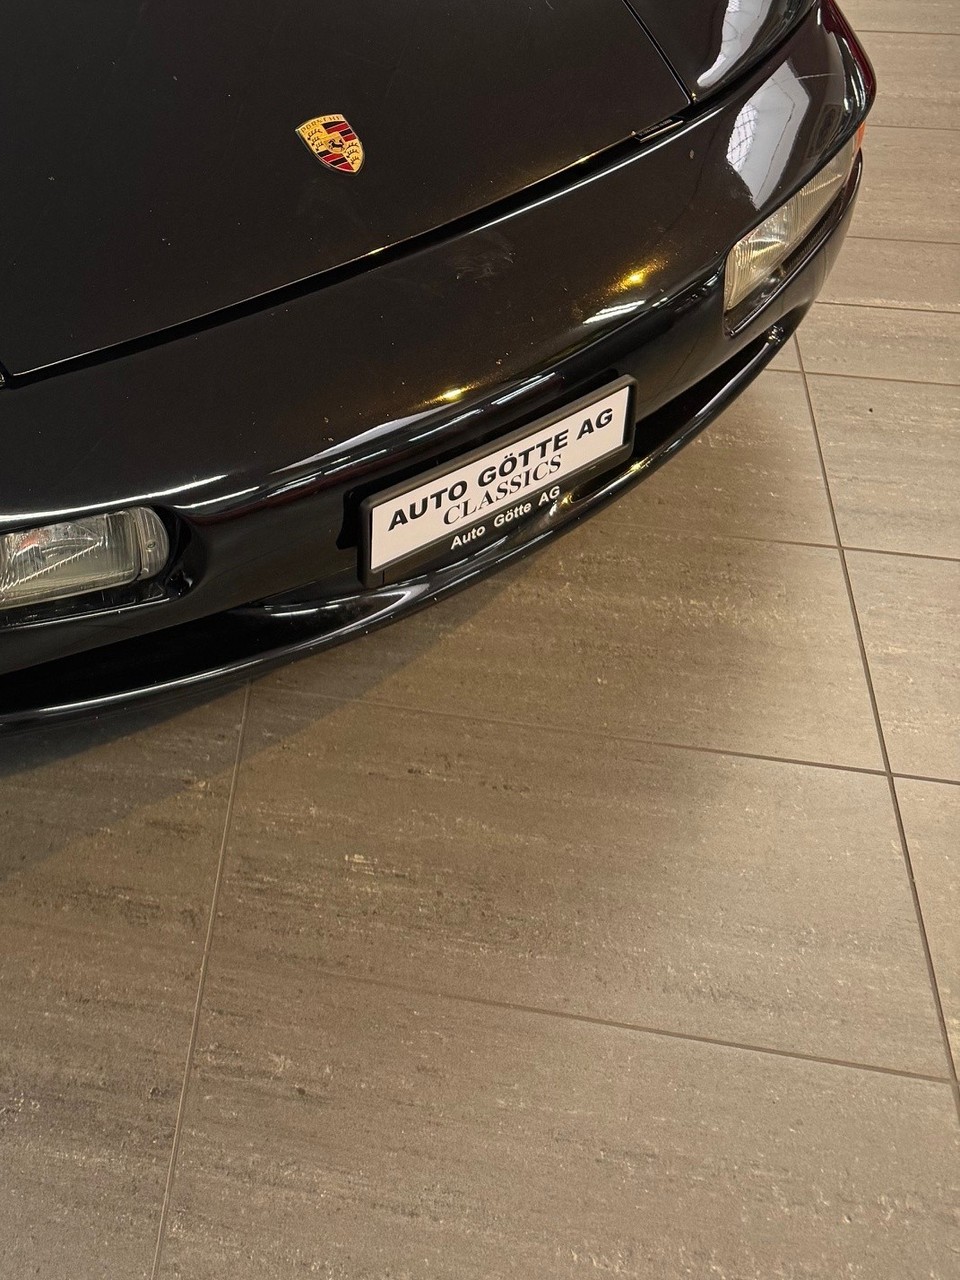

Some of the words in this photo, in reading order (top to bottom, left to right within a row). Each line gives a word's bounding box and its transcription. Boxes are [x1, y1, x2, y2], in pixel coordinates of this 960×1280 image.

[387, 480, 468, 532] AUTO
[477, 428, 570, 488] GÖTTE
[576, 407, 613, 439] AG
[442, 453, 563, 526] CLASSICS
[450, 524, 486, 550] Auto
[493, 501, 532, 529] Götte
[538, 486, 561, 507] AG
